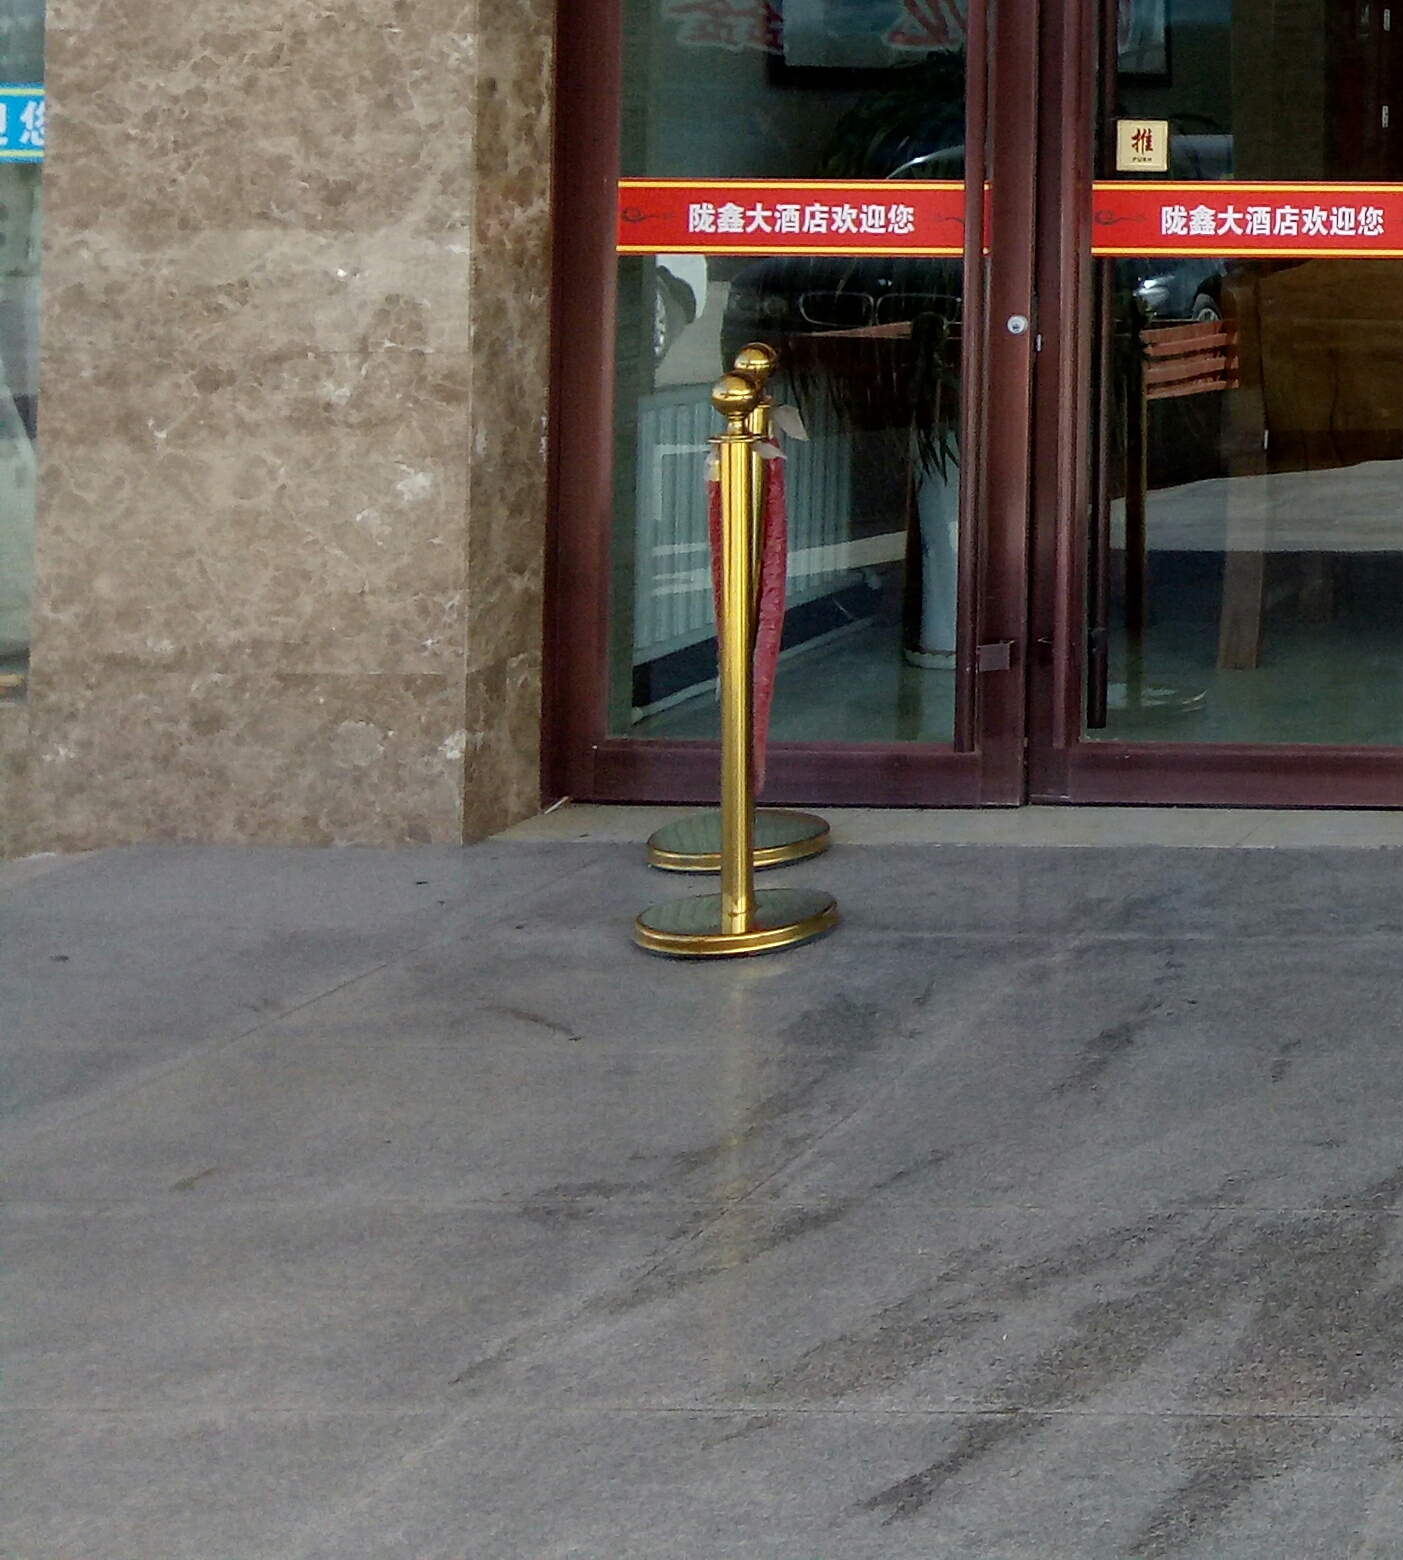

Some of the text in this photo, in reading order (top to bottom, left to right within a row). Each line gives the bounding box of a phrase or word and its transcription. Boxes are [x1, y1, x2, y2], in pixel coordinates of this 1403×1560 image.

[1131, 128, 1153, 154] 推
[688, 203, 915, 234] 陇鑫大酒店欢迎您
[1160, 205, 1384, 236] 陇鑫大酒店欢迎您
